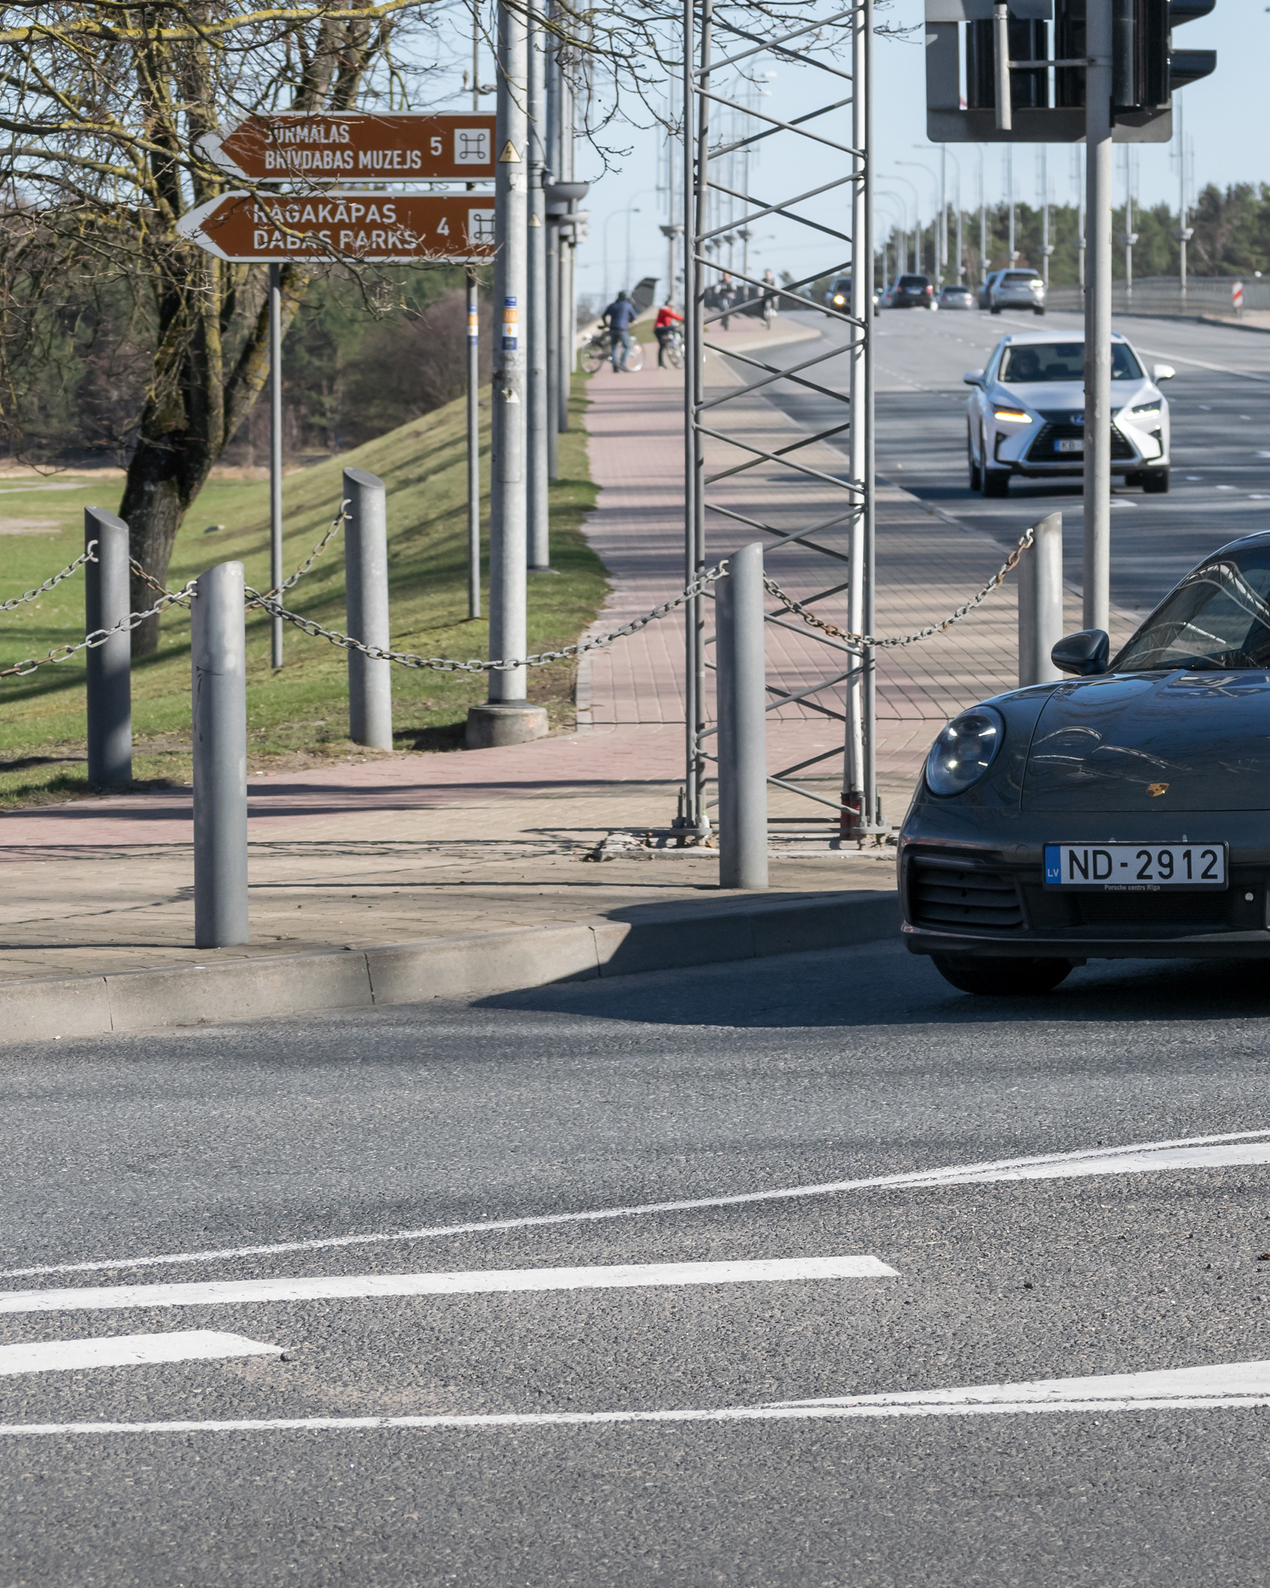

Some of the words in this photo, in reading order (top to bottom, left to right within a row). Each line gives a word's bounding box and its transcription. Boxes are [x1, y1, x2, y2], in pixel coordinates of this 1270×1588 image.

[430, 136, 442, 156] 5
[359, 150, 422, 169] MUZEJS
[437, 217, 450, 236] 4
[253, 230, 332, 249] DABAS
[339, 230, 417, 249] PARKS
[1047, 868, 1060, 877] LV
[1069, 849, 1218, 880] ND-2912
